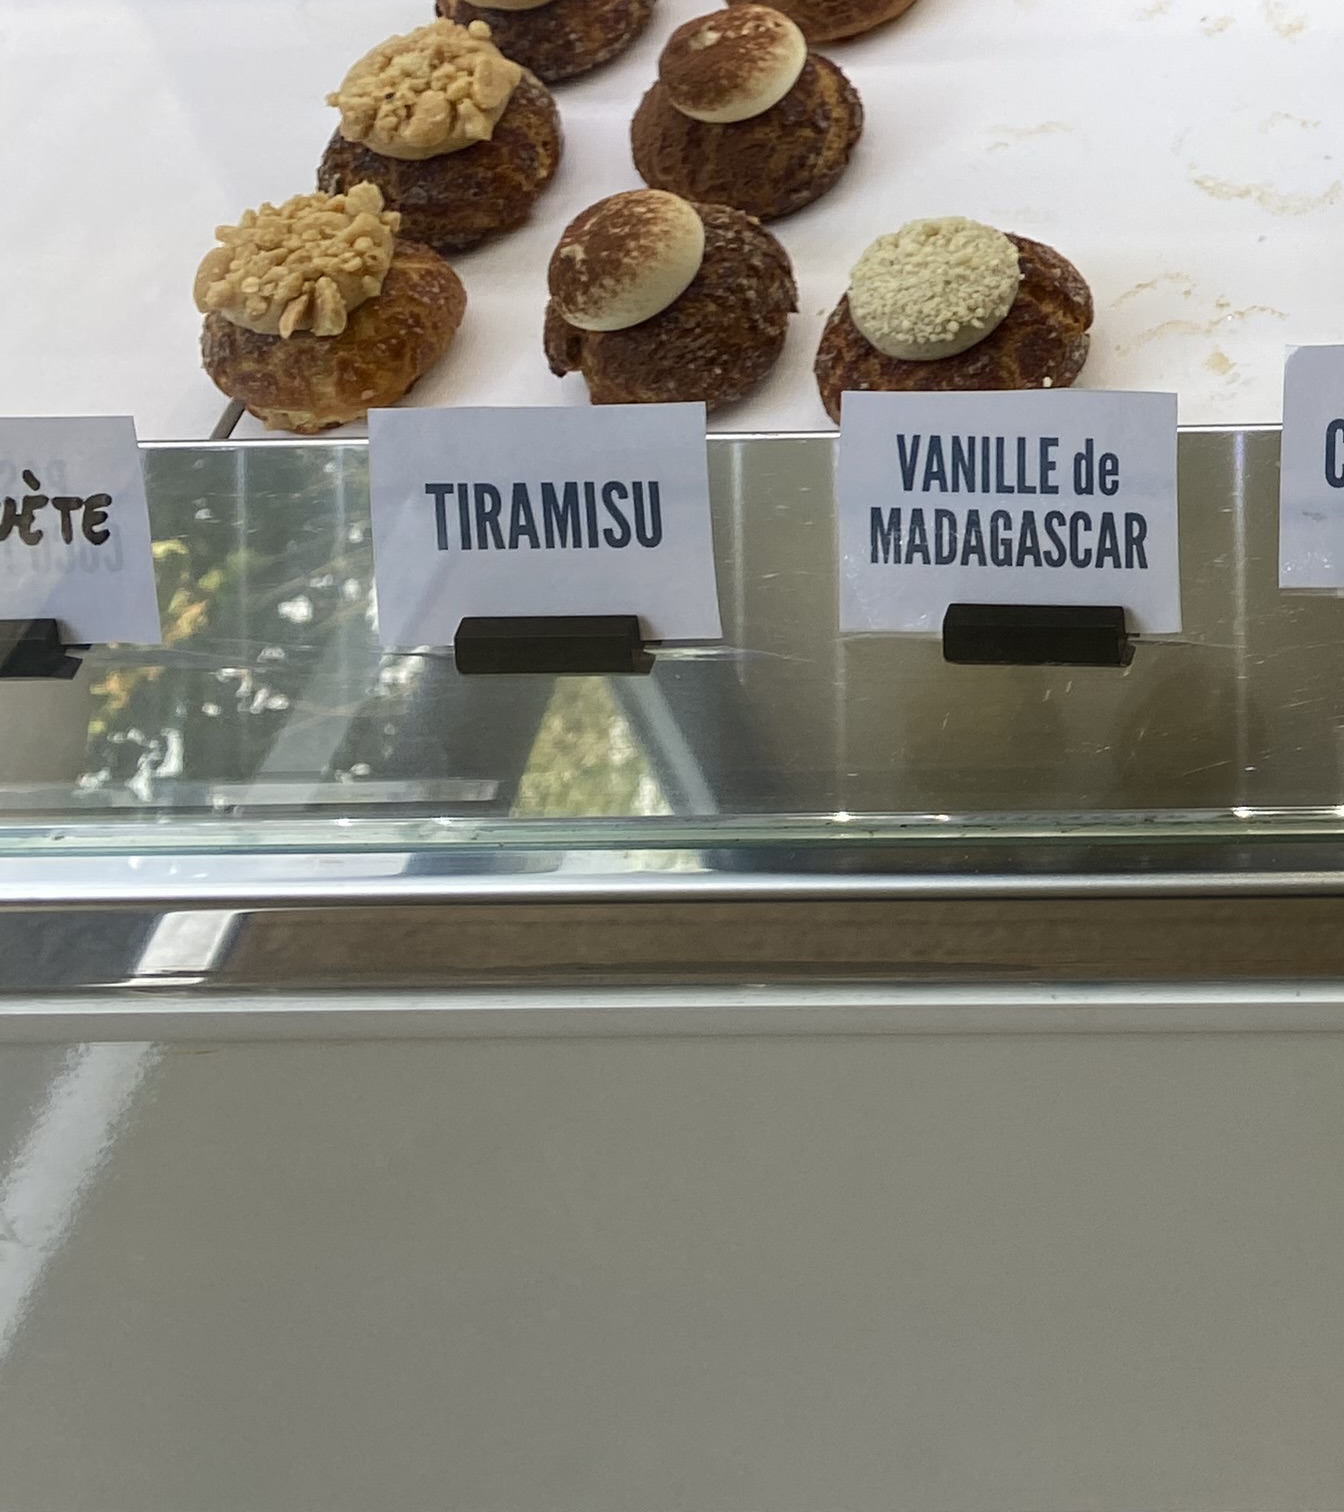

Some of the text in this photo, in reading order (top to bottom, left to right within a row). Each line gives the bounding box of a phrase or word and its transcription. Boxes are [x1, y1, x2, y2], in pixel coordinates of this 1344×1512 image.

[894, 433, 1121, 497] VANILLE de
[423, 479, 664, 552] TIRAMISU
[869, 505, 1149, 571] MADAGASCAR
